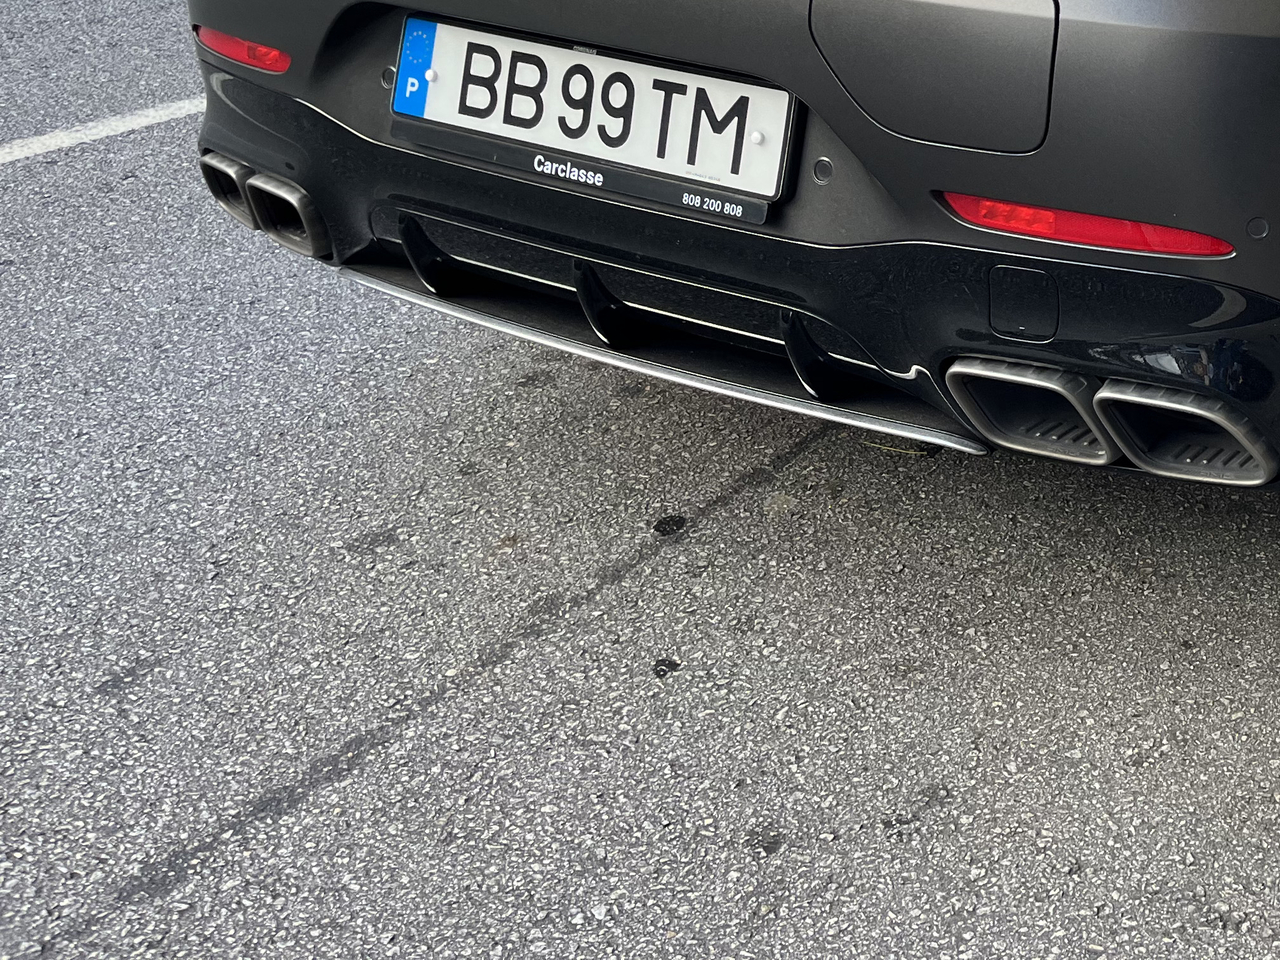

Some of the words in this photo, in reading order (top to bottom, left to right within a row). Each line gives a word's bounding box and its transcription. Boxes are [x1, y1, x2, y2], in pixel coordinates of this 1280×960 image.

[405, 77, 419, 98] P
[533, 154, 604, 186] Carclasse
[682, 192, 701, 207] 808
[703, 197, 722, 212] 200
[723, 202, 743, 217] 808
